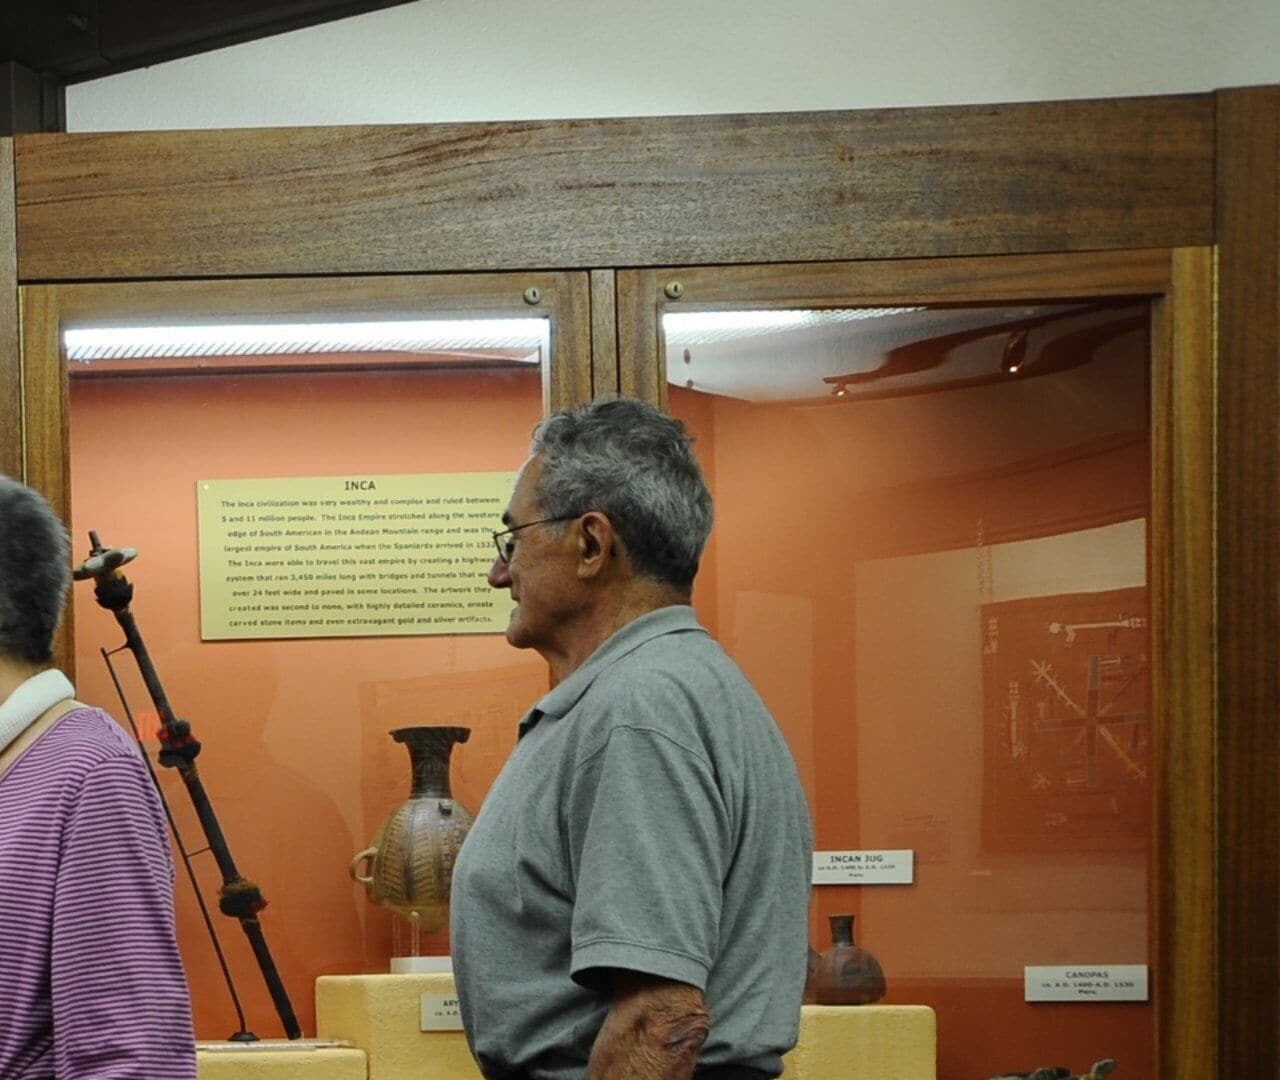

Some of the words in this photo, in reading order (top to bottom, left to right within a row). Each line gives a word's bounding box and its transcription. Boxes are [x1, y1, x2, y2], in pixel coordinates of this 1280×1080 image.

[345, 480, 376, 491] INCA
[830, 855, 861, 863] INCAN
[1065, 971, 1109, 979] CANOPAS
